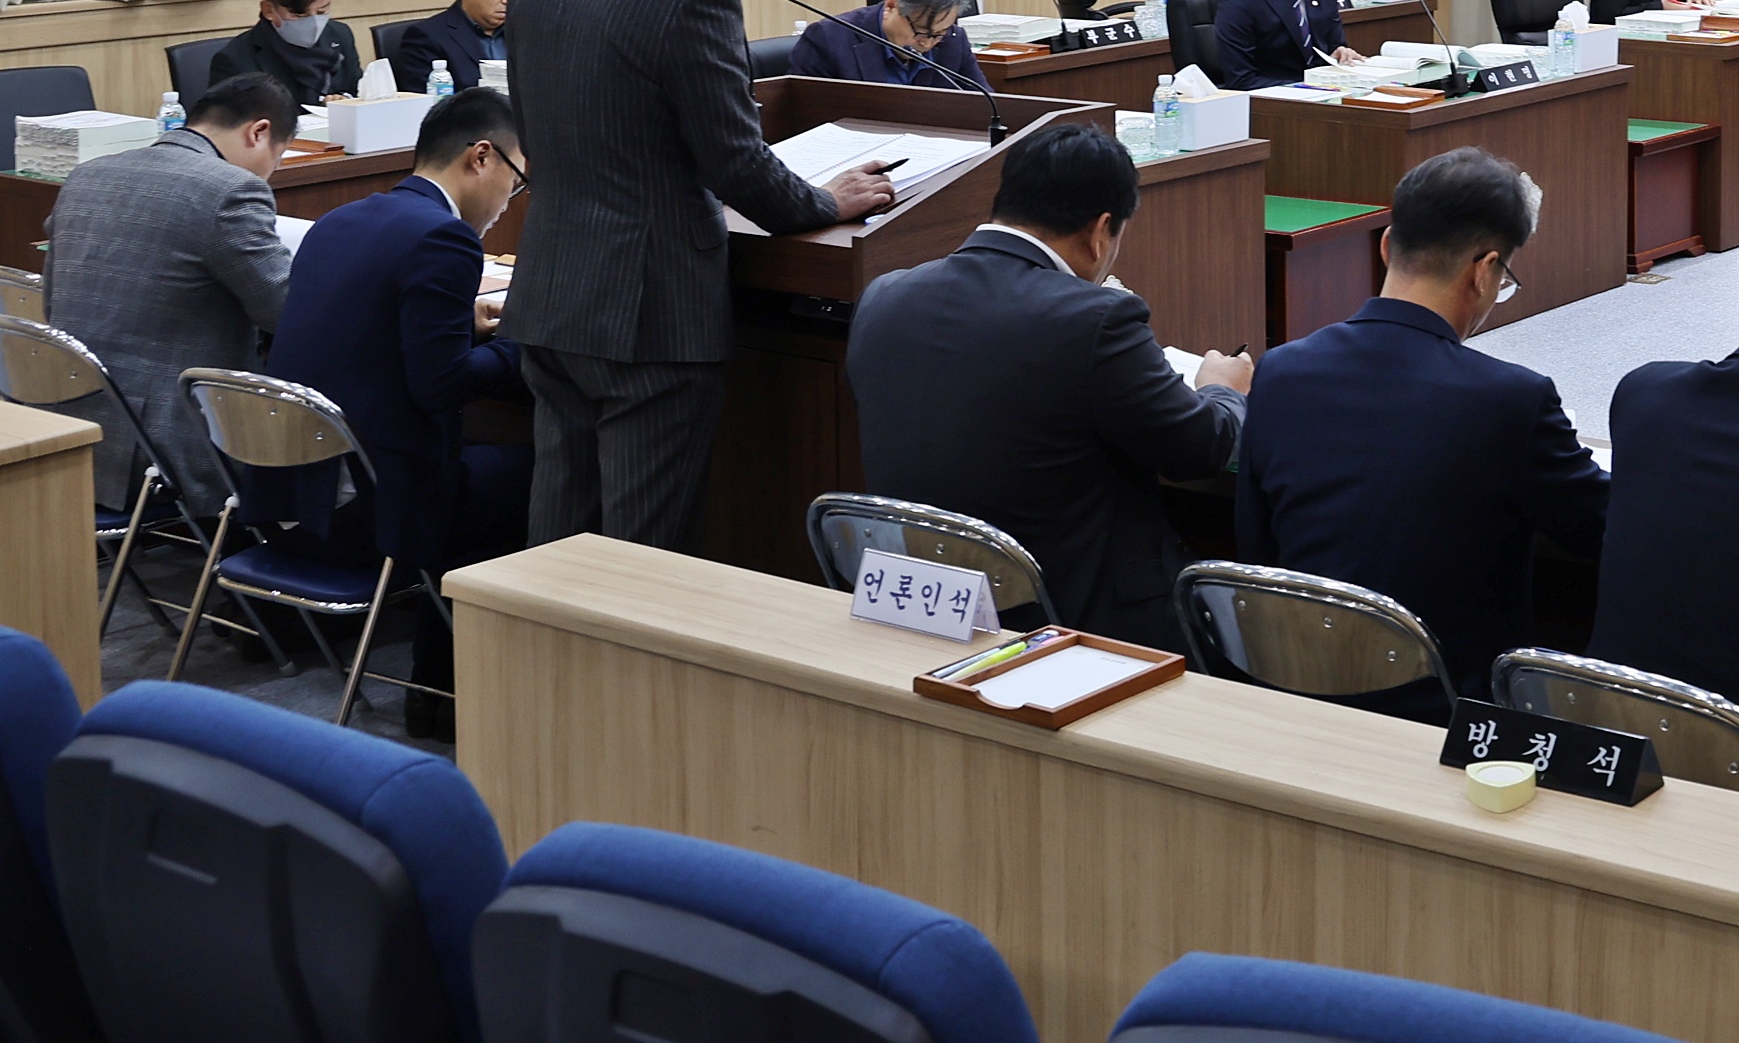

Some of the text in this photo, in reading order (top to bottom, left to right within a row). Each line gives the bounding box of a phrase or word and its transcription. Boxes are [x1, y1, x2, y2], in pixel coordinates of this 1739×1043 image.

[1085, 23, 1136, 45] 부군수
[864, 569, 971, 623] 언론인석
[1467, 720, 1622, 787] 방청석
